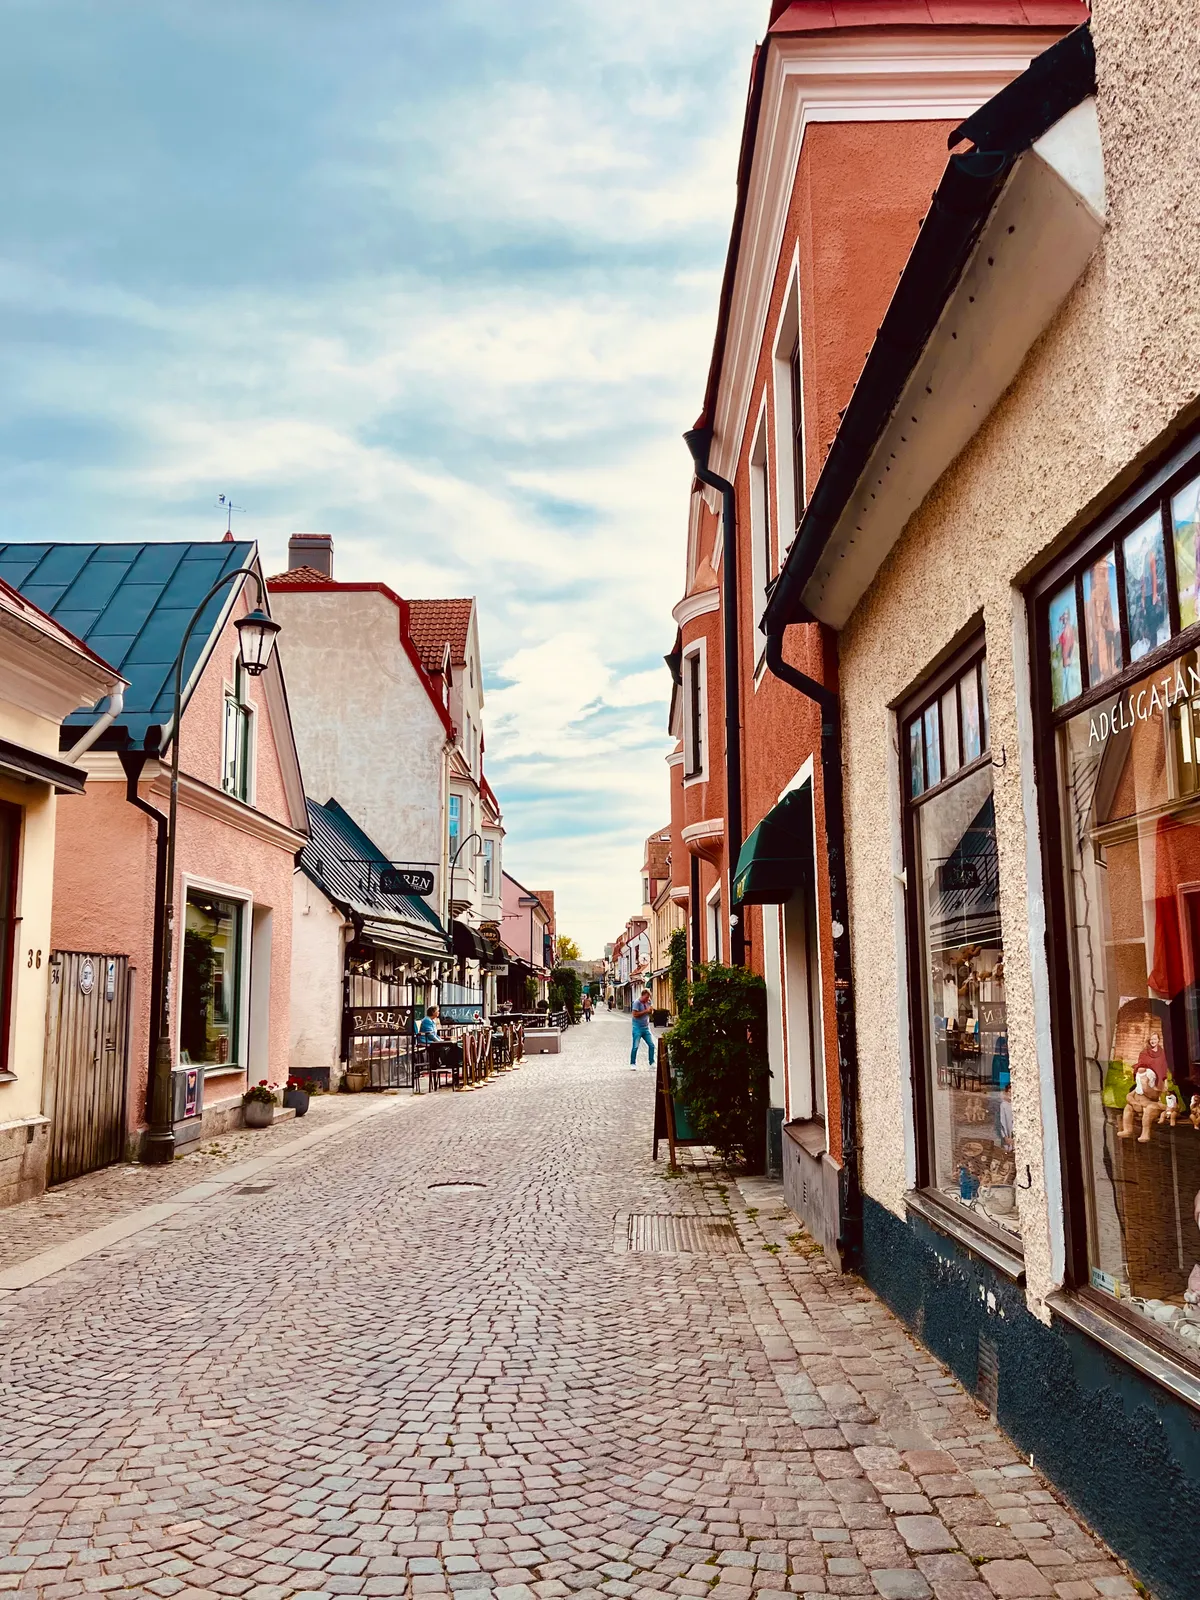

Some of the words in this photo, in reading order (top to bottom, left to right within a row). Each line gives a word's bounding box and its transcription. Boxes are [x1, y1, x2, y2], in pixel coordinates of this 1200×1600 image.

[27, 949, 42, 969] 36
[51, 969, 60, 984] 36
[353, 1011, 409, 1027] BAREN
